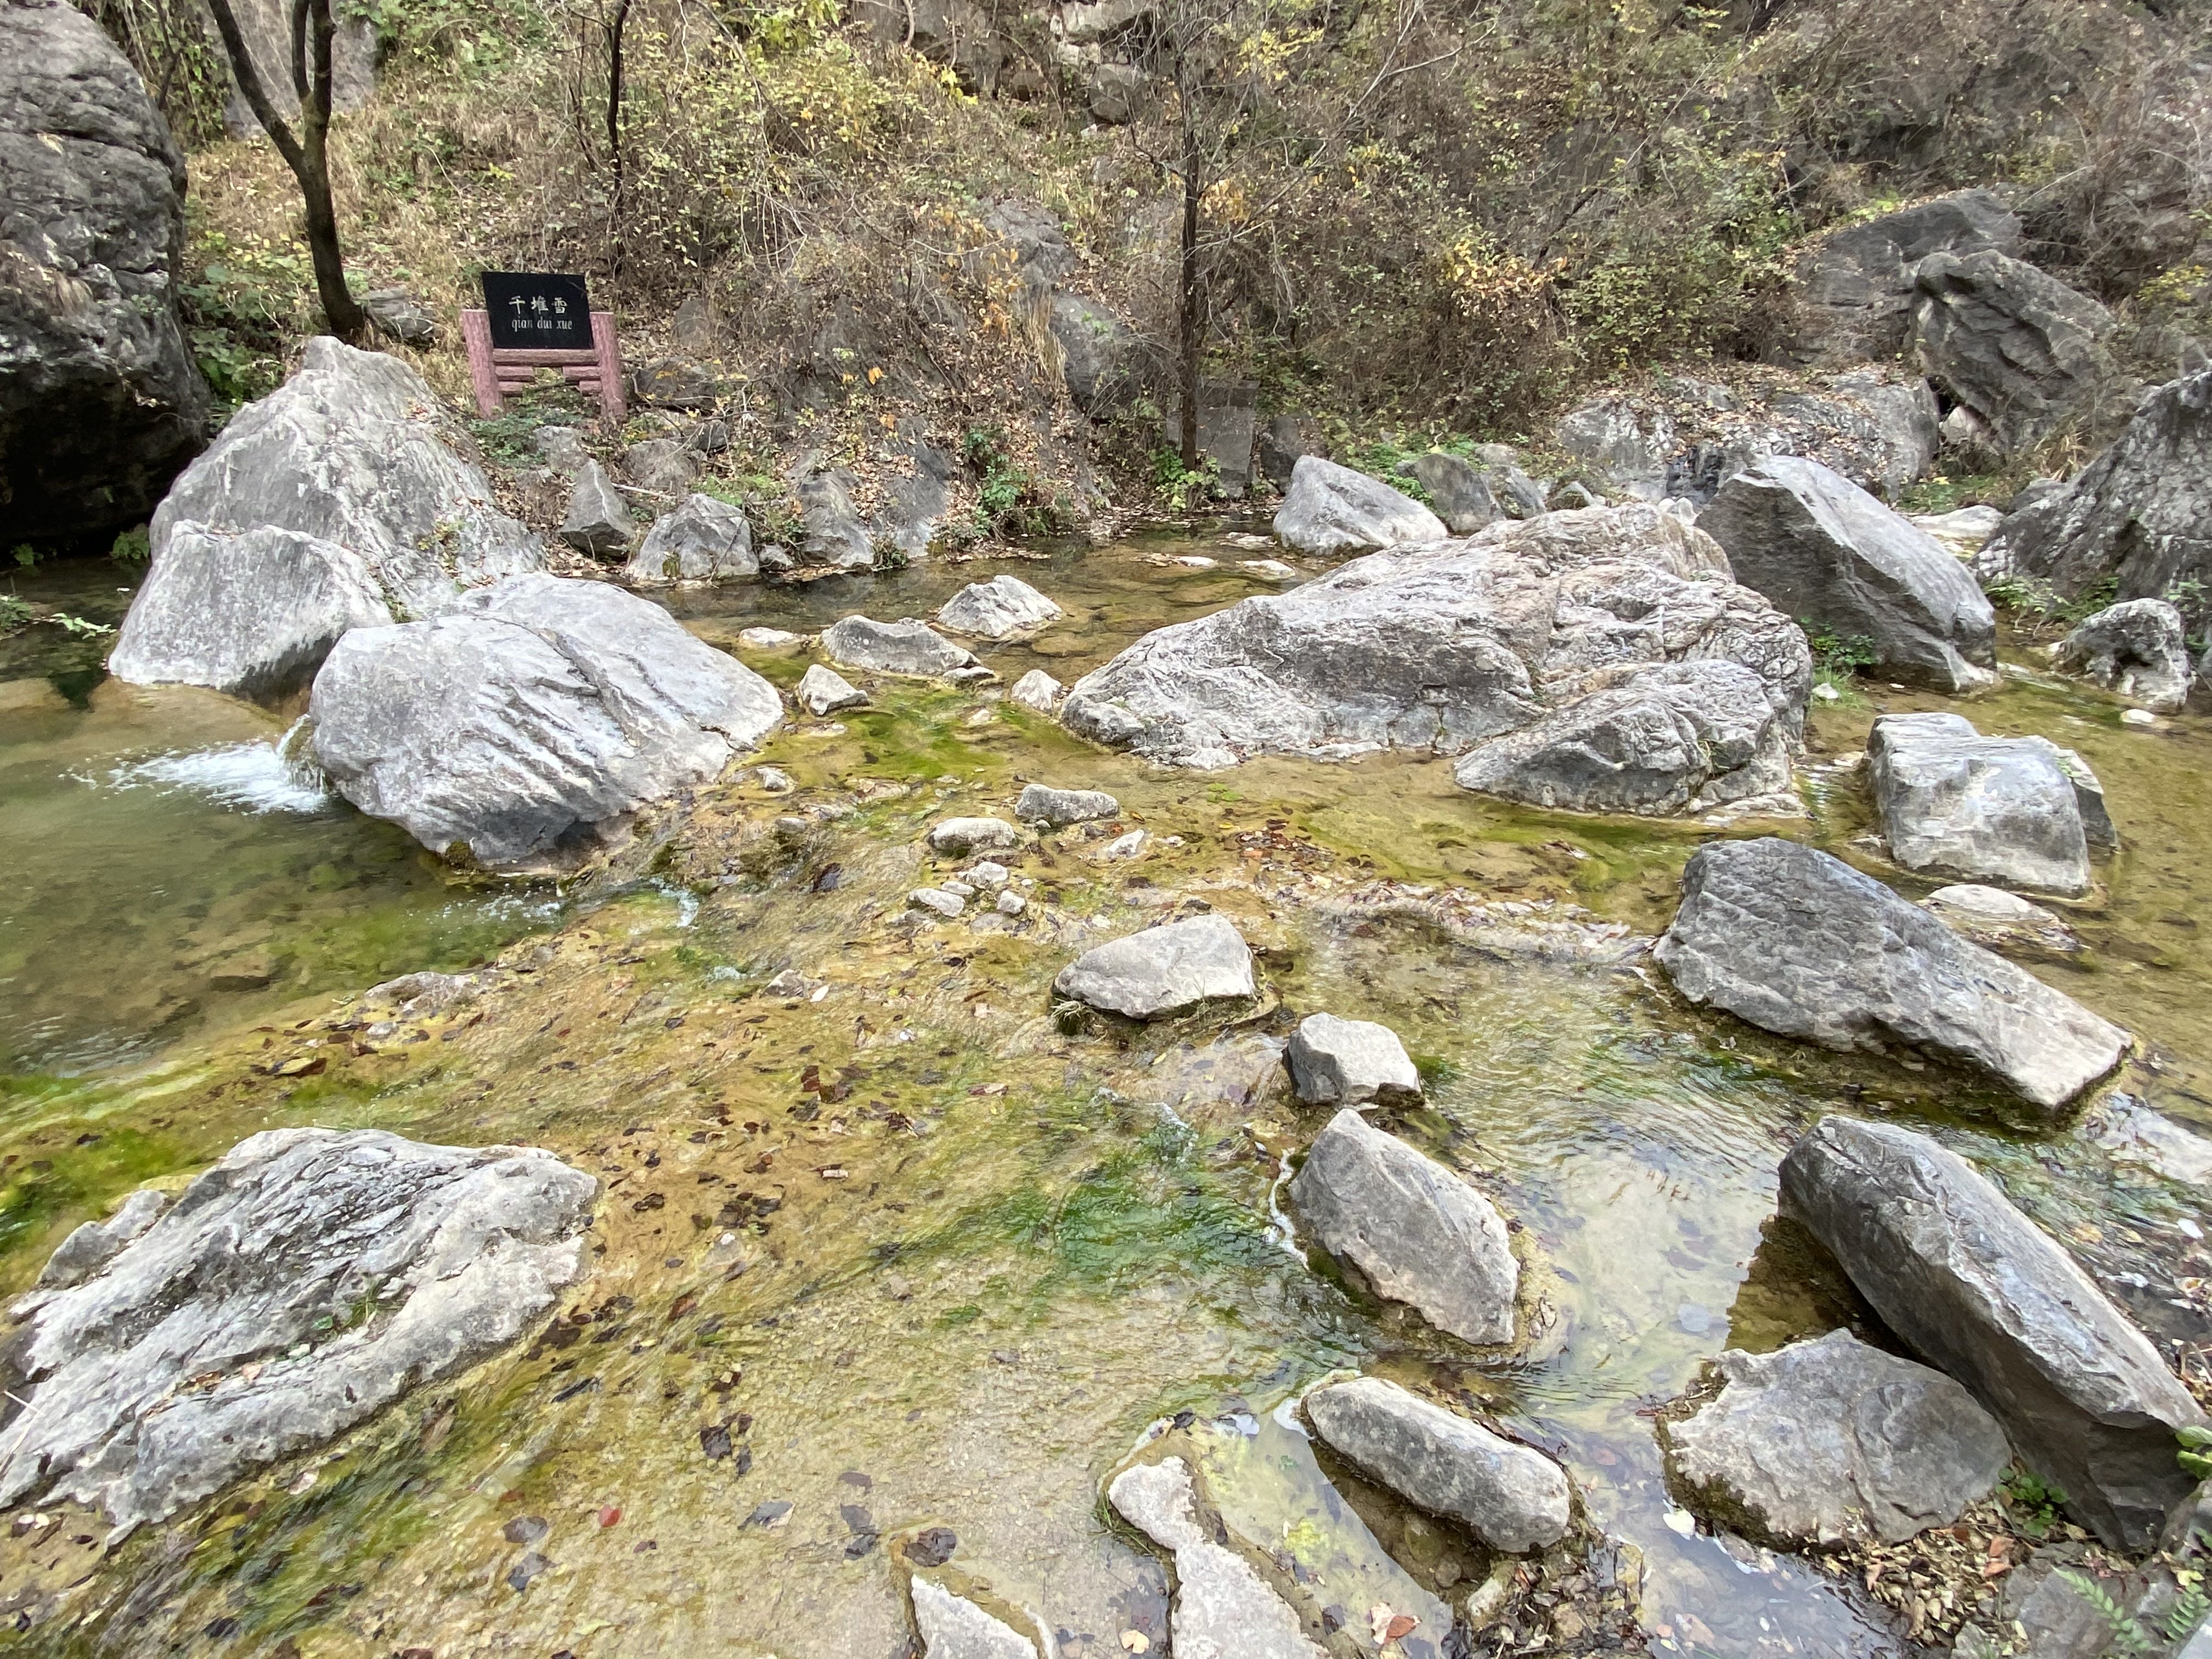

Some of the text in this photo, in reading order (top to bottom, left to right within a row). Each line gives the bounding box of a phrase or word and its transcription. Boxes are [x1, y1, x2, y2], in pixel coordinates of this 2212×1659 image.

[508, 295, 568, 315] 千堆雪
[511, 315, 573, 332] qian dui xue
